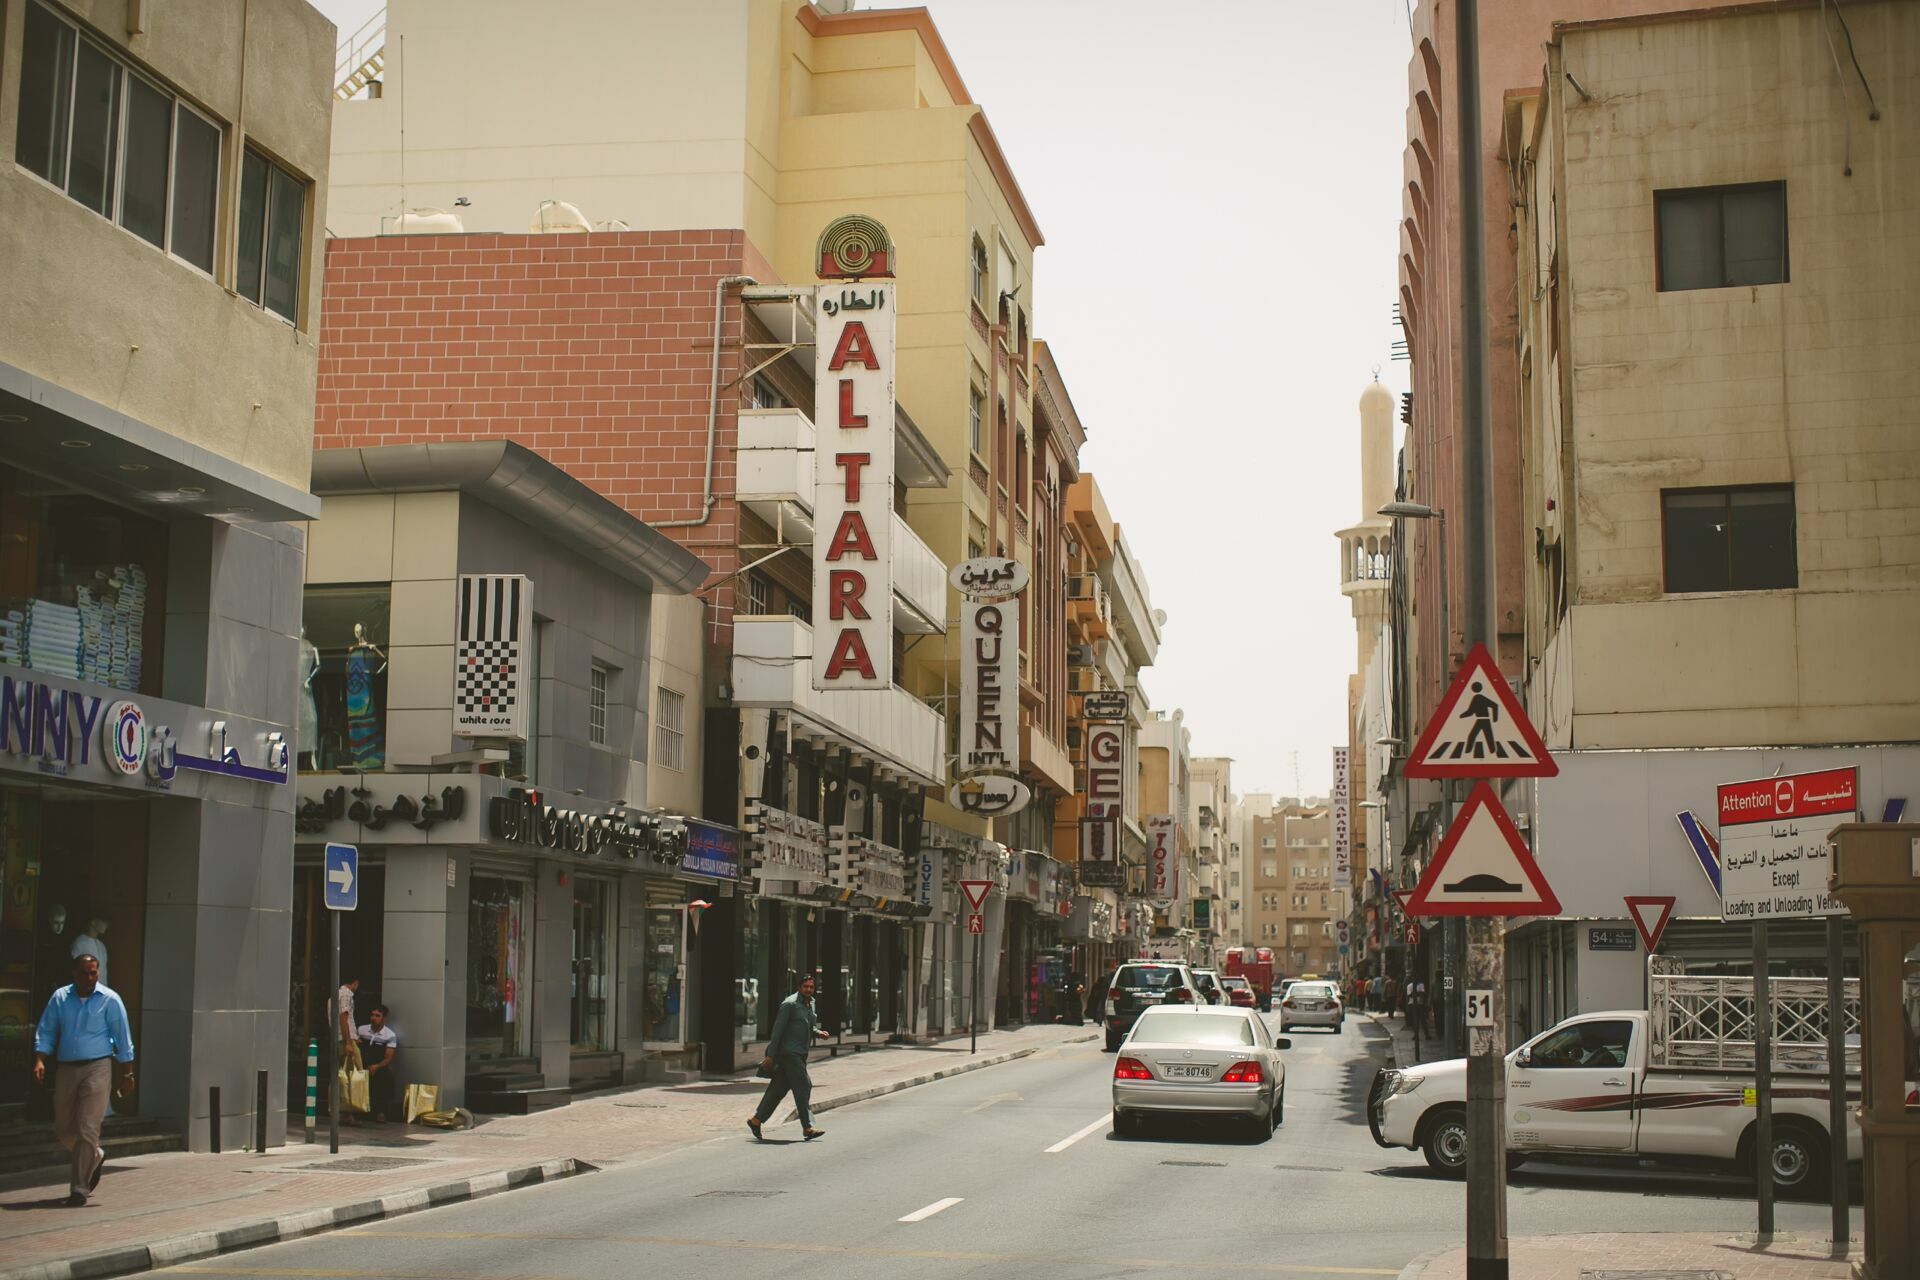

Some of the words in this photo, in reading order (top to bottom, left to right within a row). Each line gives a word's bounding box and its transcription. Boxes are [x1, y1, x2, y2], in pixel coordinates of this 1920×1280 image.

[960, 561, 1016, 585] كوين
[974, 606, 1004, 750] QUEEN
[459, 715, 488, 725] white
[489, 717, 511, 725] rose
[968, 751, 1011, 765] INT'L
[1335, 750, 1347, 797] HORIZON
[1722, 793, 1772, 812] Attention
[1803, 780, 1852, 806] تنبيه
[1335, 806, 1348, 873] APARTMENTS
[1152, 832, 1168, 890] TOSH
[1727, 849, 1757, 870] التفريغ
[1760, 857, 1766, 867] و
[1768, 845, 1803, 866] التحميل
[1772, 870, 1800, 889] Except
[1725, 900, 1754, 917] Loading
[1758, 898, 1771, 914] and
[1775, 895, 1812, 914] Unloading
[1592, 931, 1608, 944] 54
[1468, 995, 1490, 1019] 51
[1166, 1067, 1172, 1075] F
[1185, 1067, 1210, 1077] 80746
